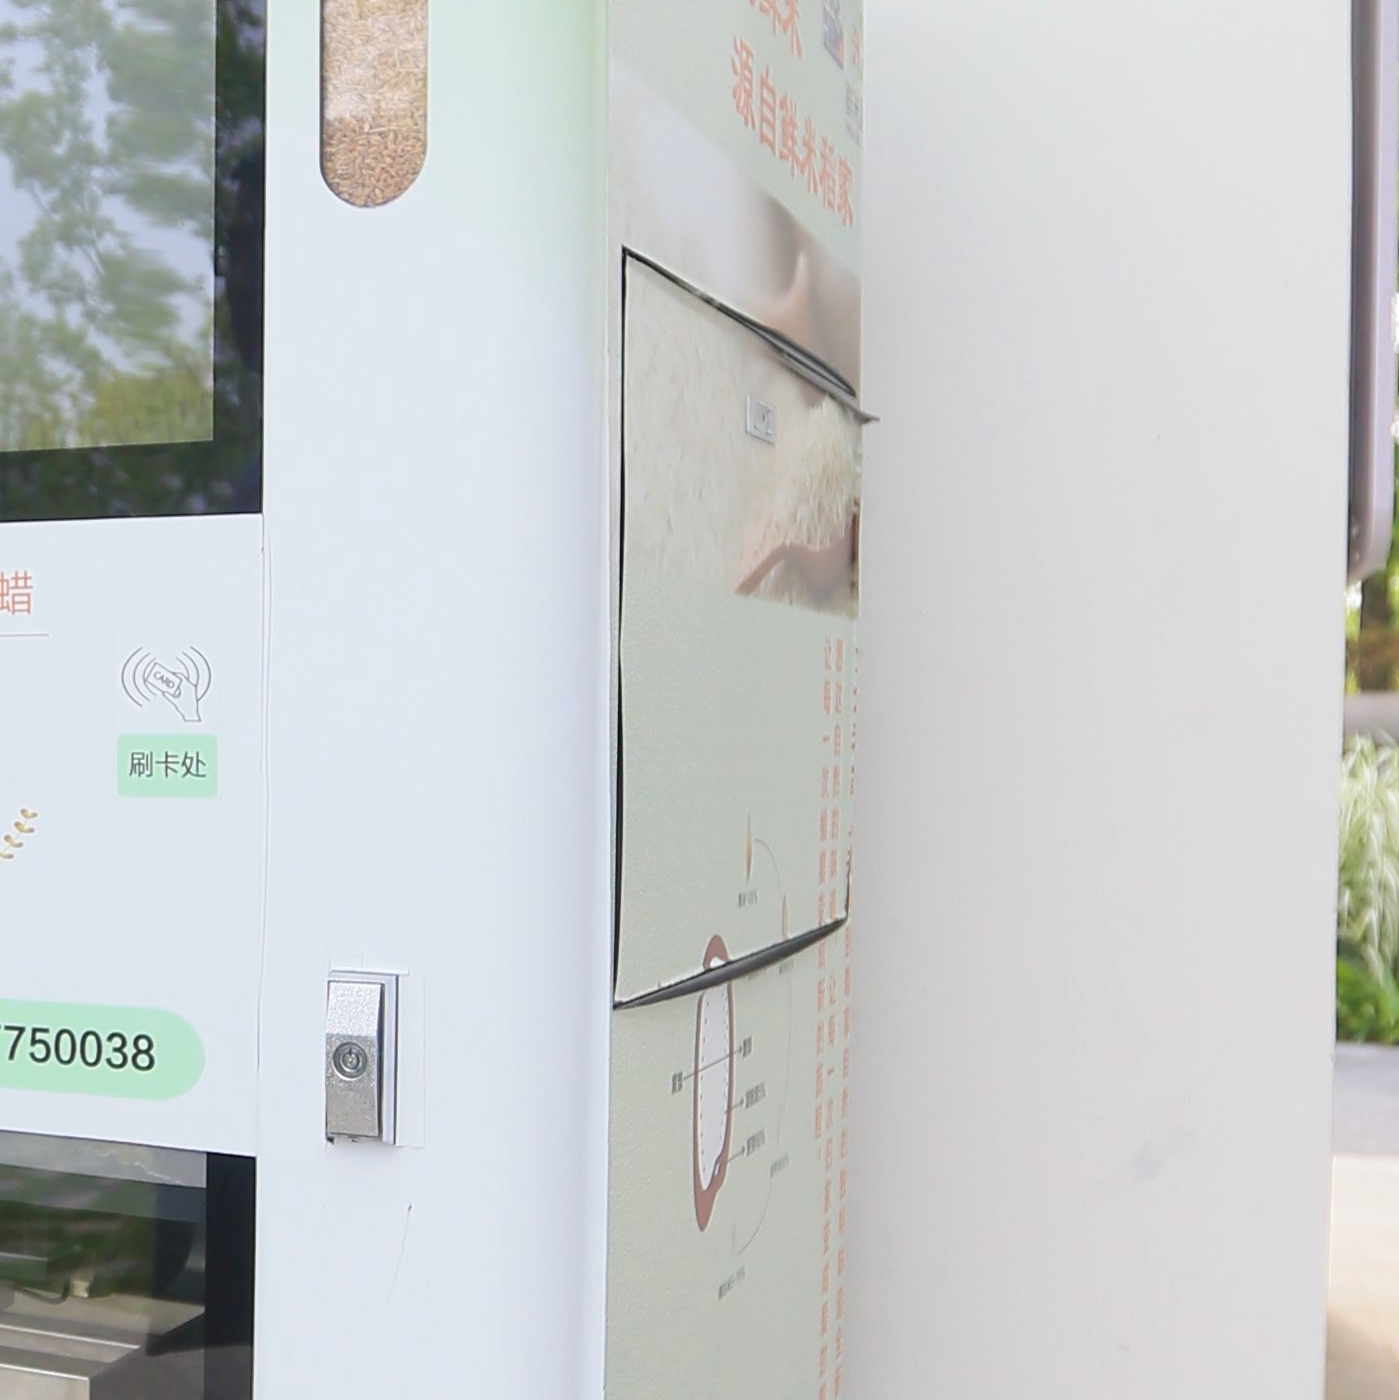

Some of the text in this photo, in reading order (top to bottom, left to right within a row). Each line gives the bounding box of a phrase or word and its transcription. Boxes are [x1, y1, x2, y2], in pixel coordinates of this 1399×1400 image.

[153, 670, 175, 690] CARD
[129, 750, 207, 779] 刷卡处
